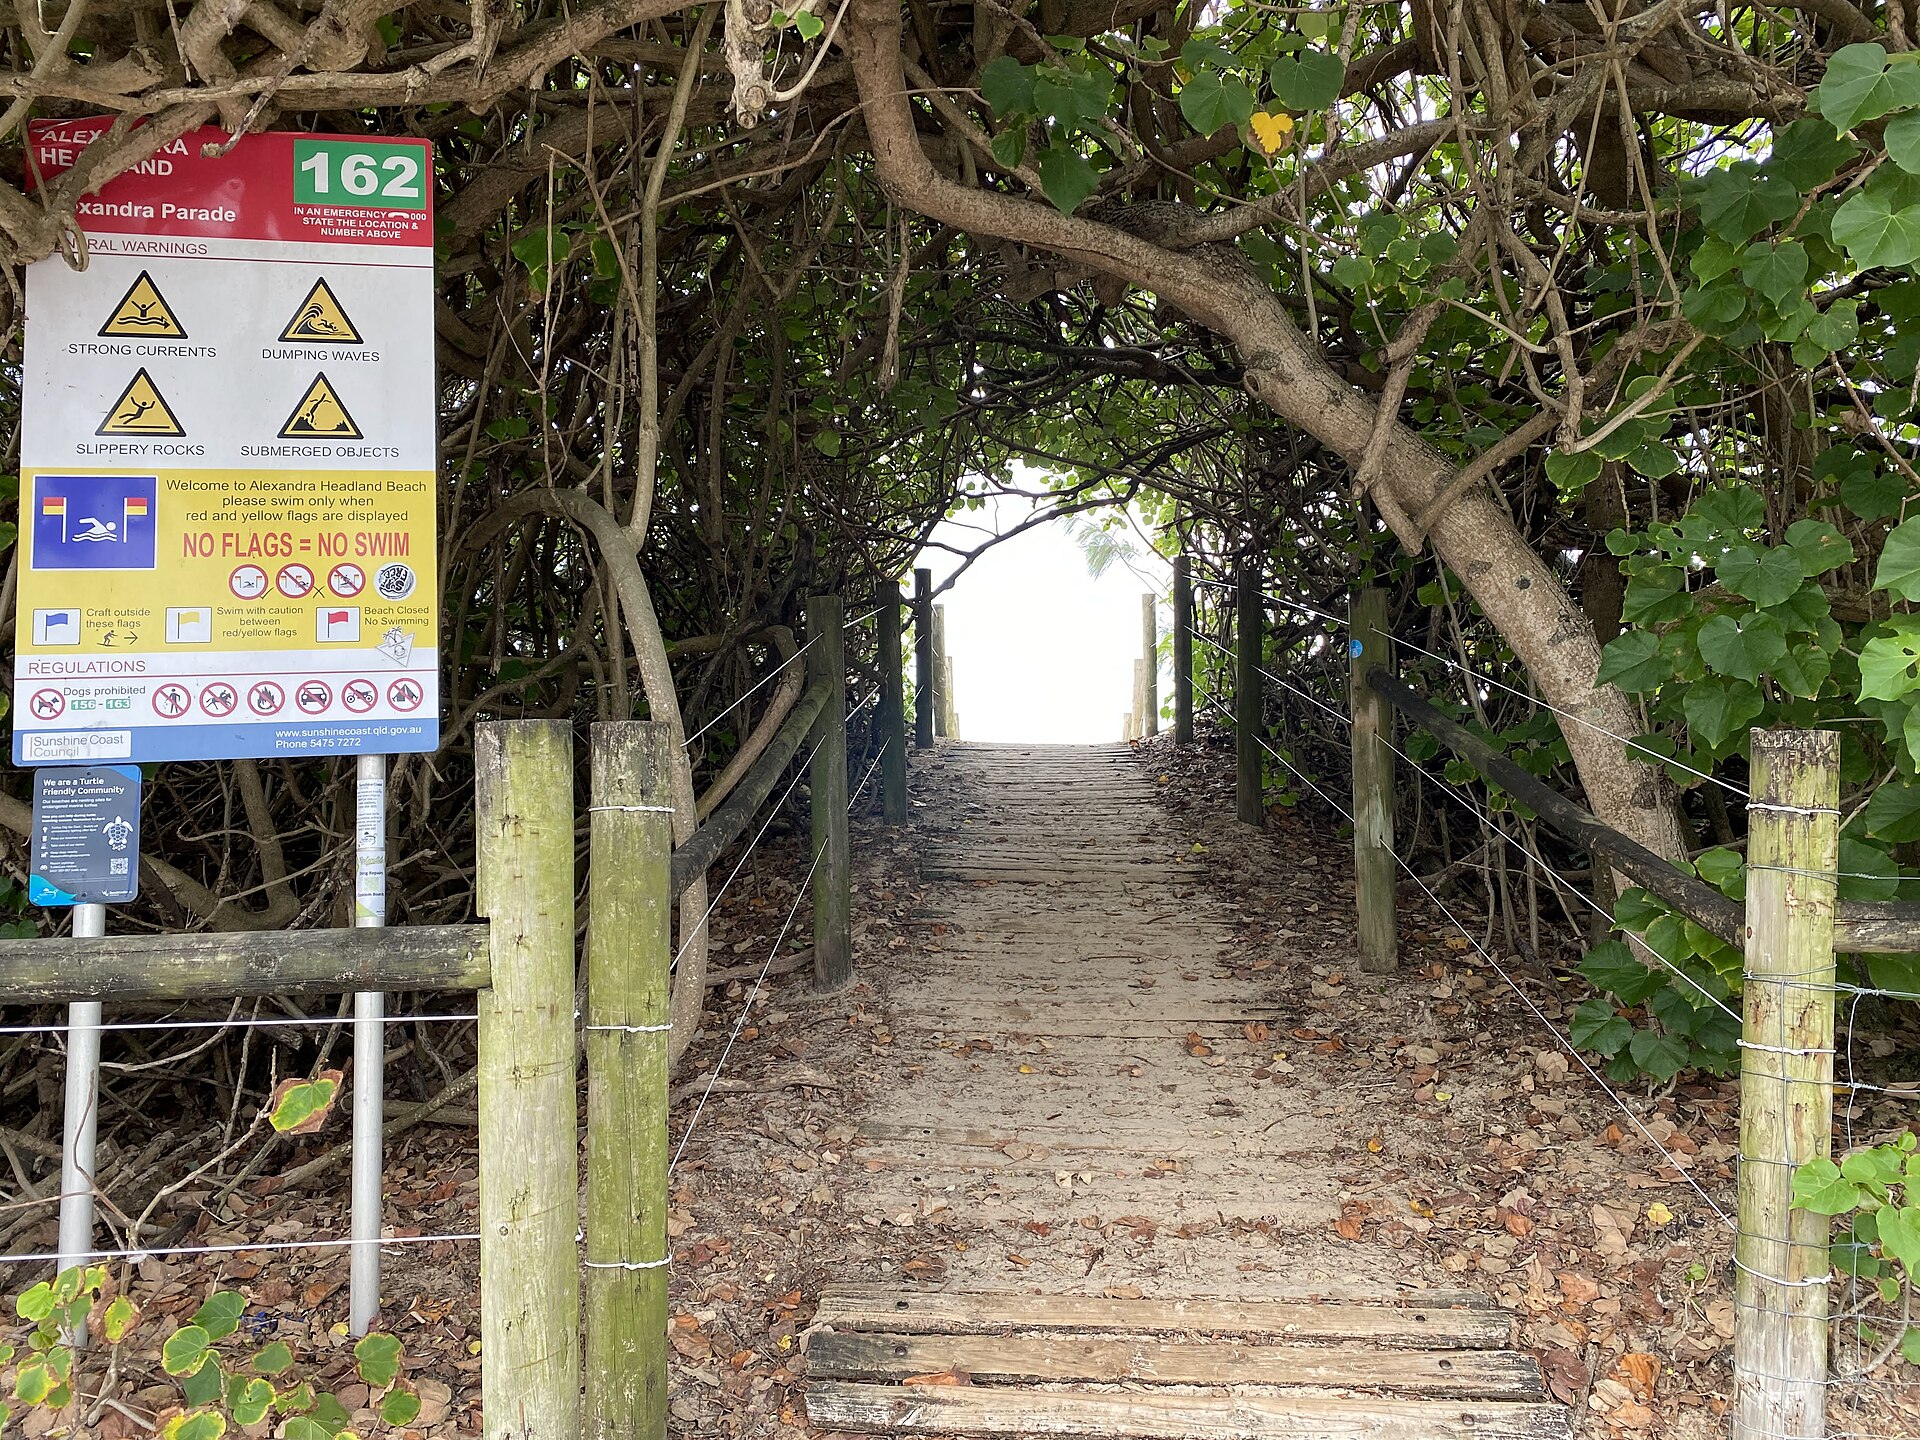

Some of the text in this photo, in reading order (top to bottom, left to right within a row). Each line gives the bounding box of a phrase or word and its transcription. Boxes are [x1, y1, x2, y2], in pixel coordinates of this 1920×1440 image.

[40, 147, 173, 176] HEAND
[302, 152, 418, 198] 162
[76, 201, 236, 222] xandra Parade
[294, 206, 304, 214] IN
[306, 208, 321, 216] AN
[324, 208, 387, 218] EMERGENCY
[302, 218, 418, 230] STATE THE LOCATION &
[320, 228, 401, 239] NUMBER ABOVE
[120, 240, 208, 255] WARNINGS
[68, 343, 217, 358] STRONG CURRENTS
[262, 348, 380, 363] DUMPING WAVES
[76, 443, 205, 456] SLIPPERY ROCKS
[240, 445, 400, 459] SUBMERGED OBJECTS
[166, 480, 427, 492] Welcome to Alexandra Headland Beach
[222, 496, 374, 508] please swim only when
[186, 510, 408, 524] red and yellow flags are displayed
[183, 532, 410, 558] NO FLAGS = NO SWIM
[86, 608, 150, 617] Craft outside
[216, 606, 304, 615] Swim with caution
[364, 606, 430, 615] Beach Closed
[86, 618, 141, 629] these flags
[239, 618, 281, 626] between
[364, 617, 430, 627] No Swimming
[222, 628, 298, 638] red/yellow flags
[28, 660, 146, 674] REGULATIONS
[64, 686, 146, 698] Dogs prohibited
[72, 700, 96, 710] 156
[107, 700, 130, 708] 163
[276, 726, 422, 738] www.sunshinecoast.qld.gov.au
[34, 734, 124, 746] Sunshine Coast
[276, 738, 361, 749] Phone 5475 7272
[34, 746, 79, 757] Council
[42, 786, 124, 796] Friendly Community
